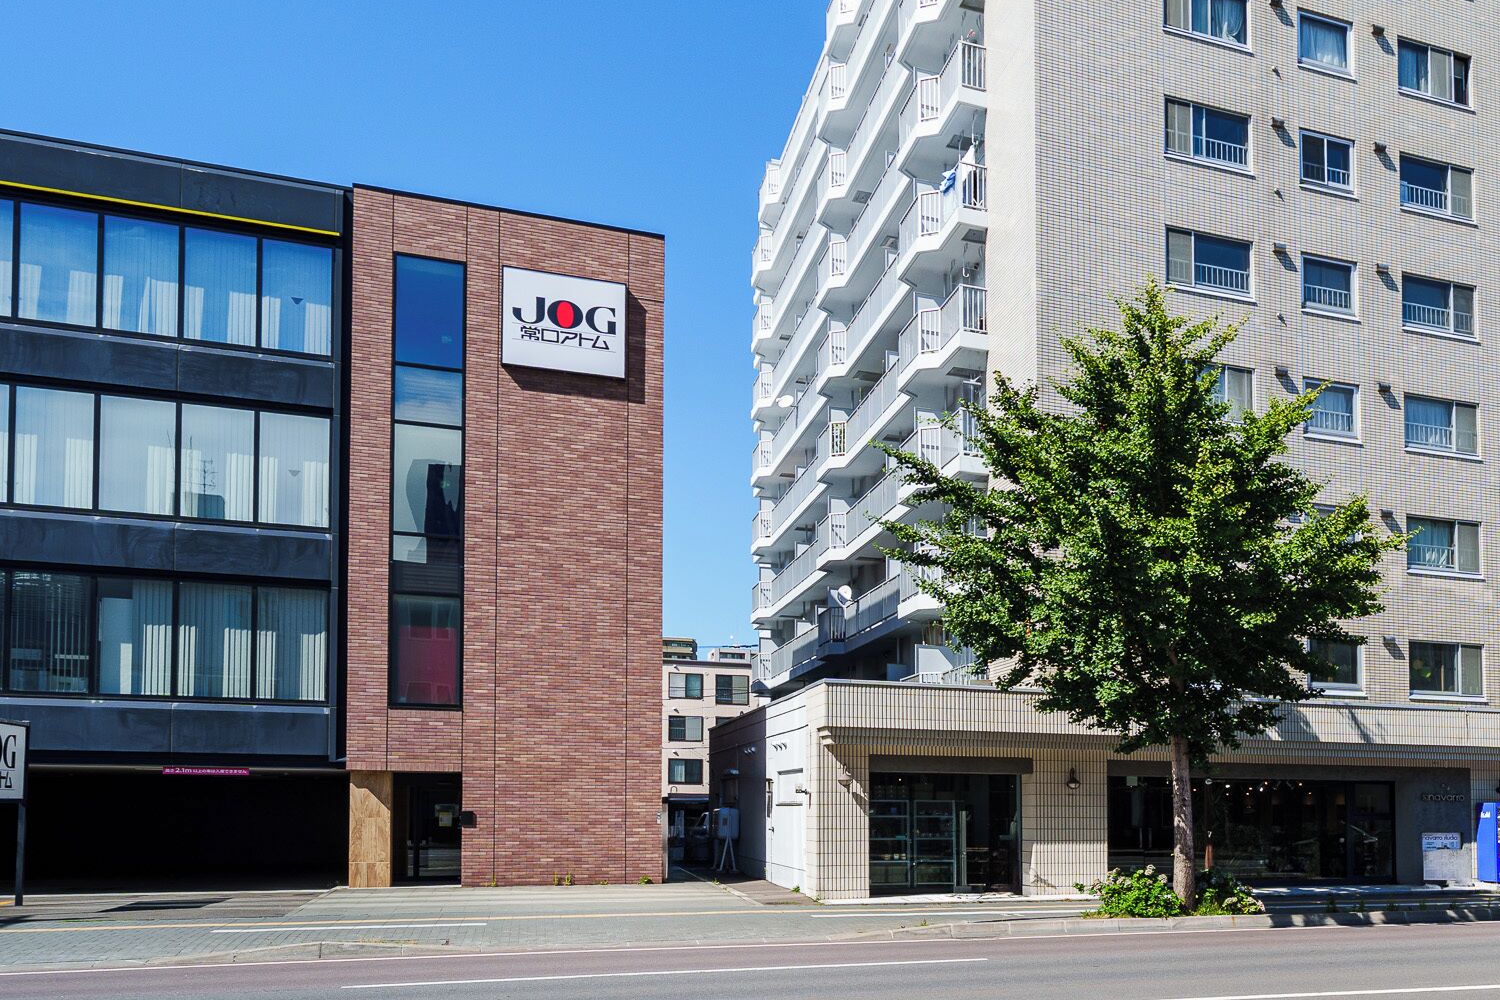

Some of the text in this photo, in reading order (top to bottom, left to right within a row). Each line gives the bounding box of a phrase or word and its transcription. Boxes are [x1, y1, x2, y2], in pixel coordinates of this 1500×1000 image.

[512, 296, 617, 335] JOG
[520, 325, 610, 350] 常口アトム
